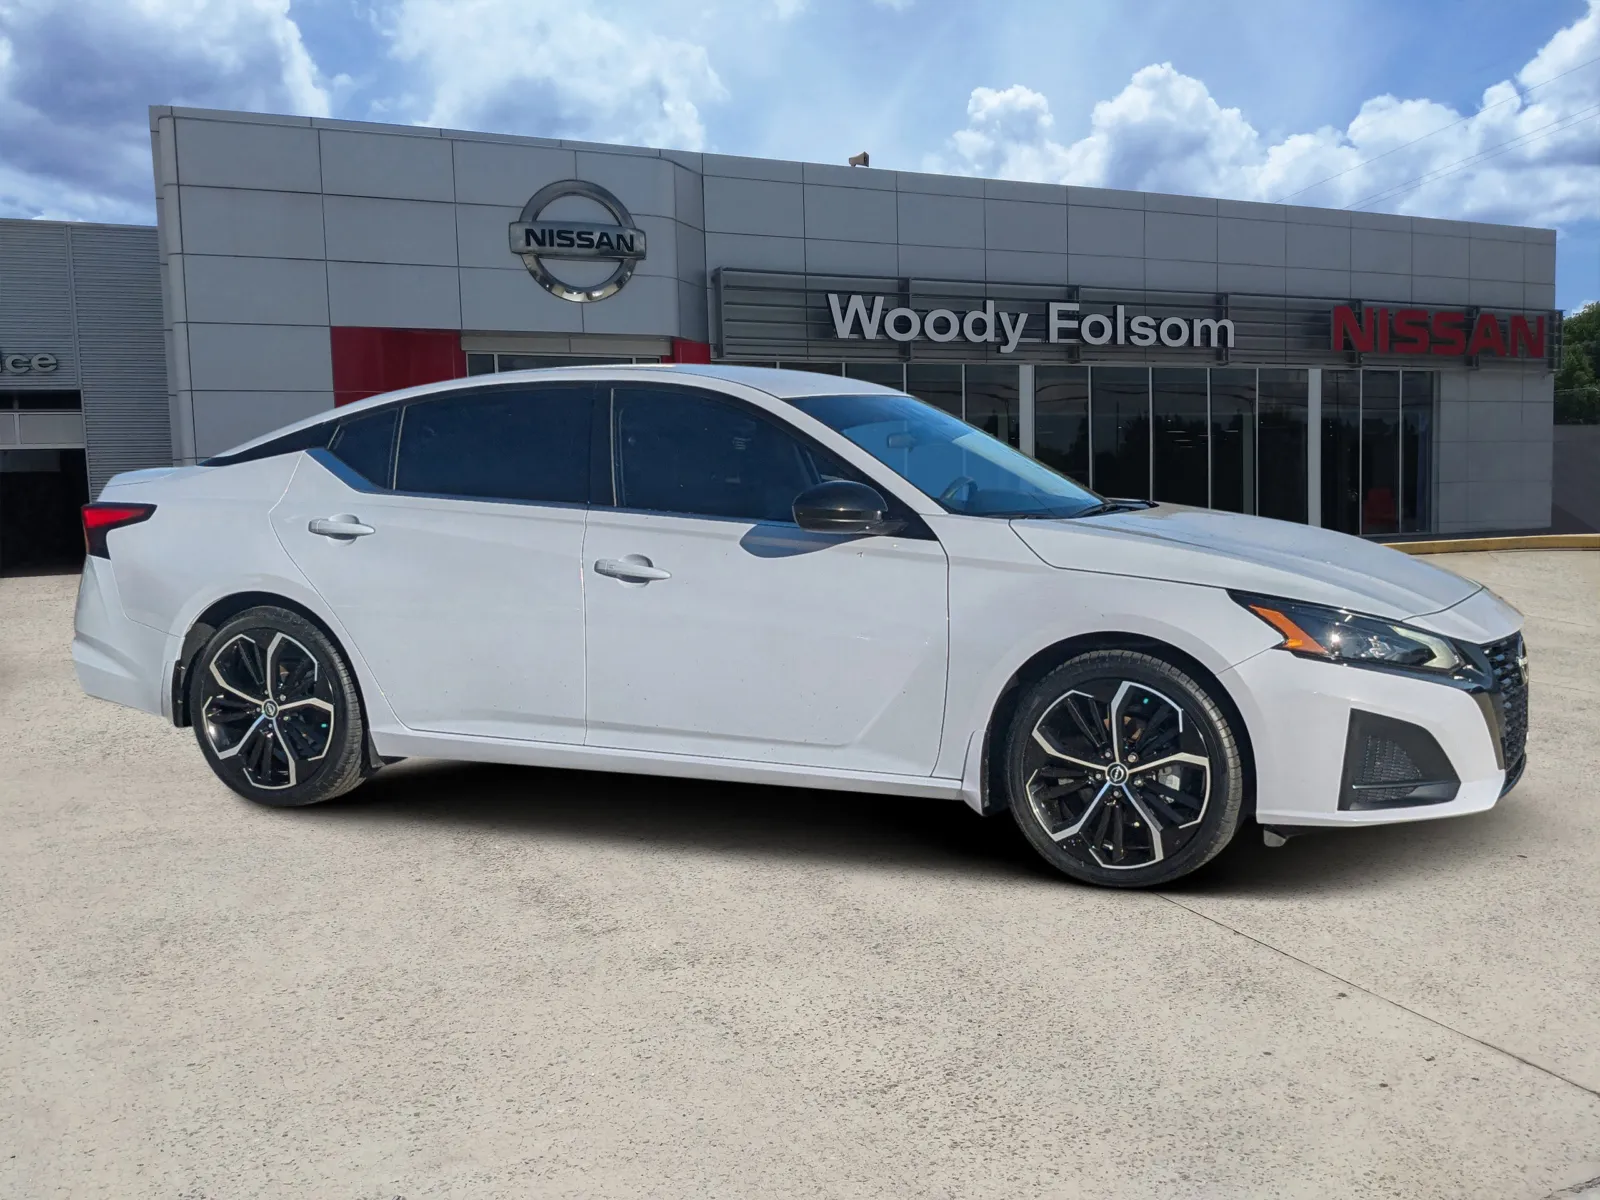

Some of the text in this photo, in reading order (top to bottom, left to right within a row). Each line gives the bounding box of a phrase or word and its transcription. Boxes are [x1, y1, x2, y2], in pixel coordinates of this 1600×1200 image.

[524, 228, 635, 252] NISSAN
[827, 293, 1236, 354] Woody Folsom
[1333, 305, 1545, 358] NISSAN
[0, 353, 57, 374] ce
